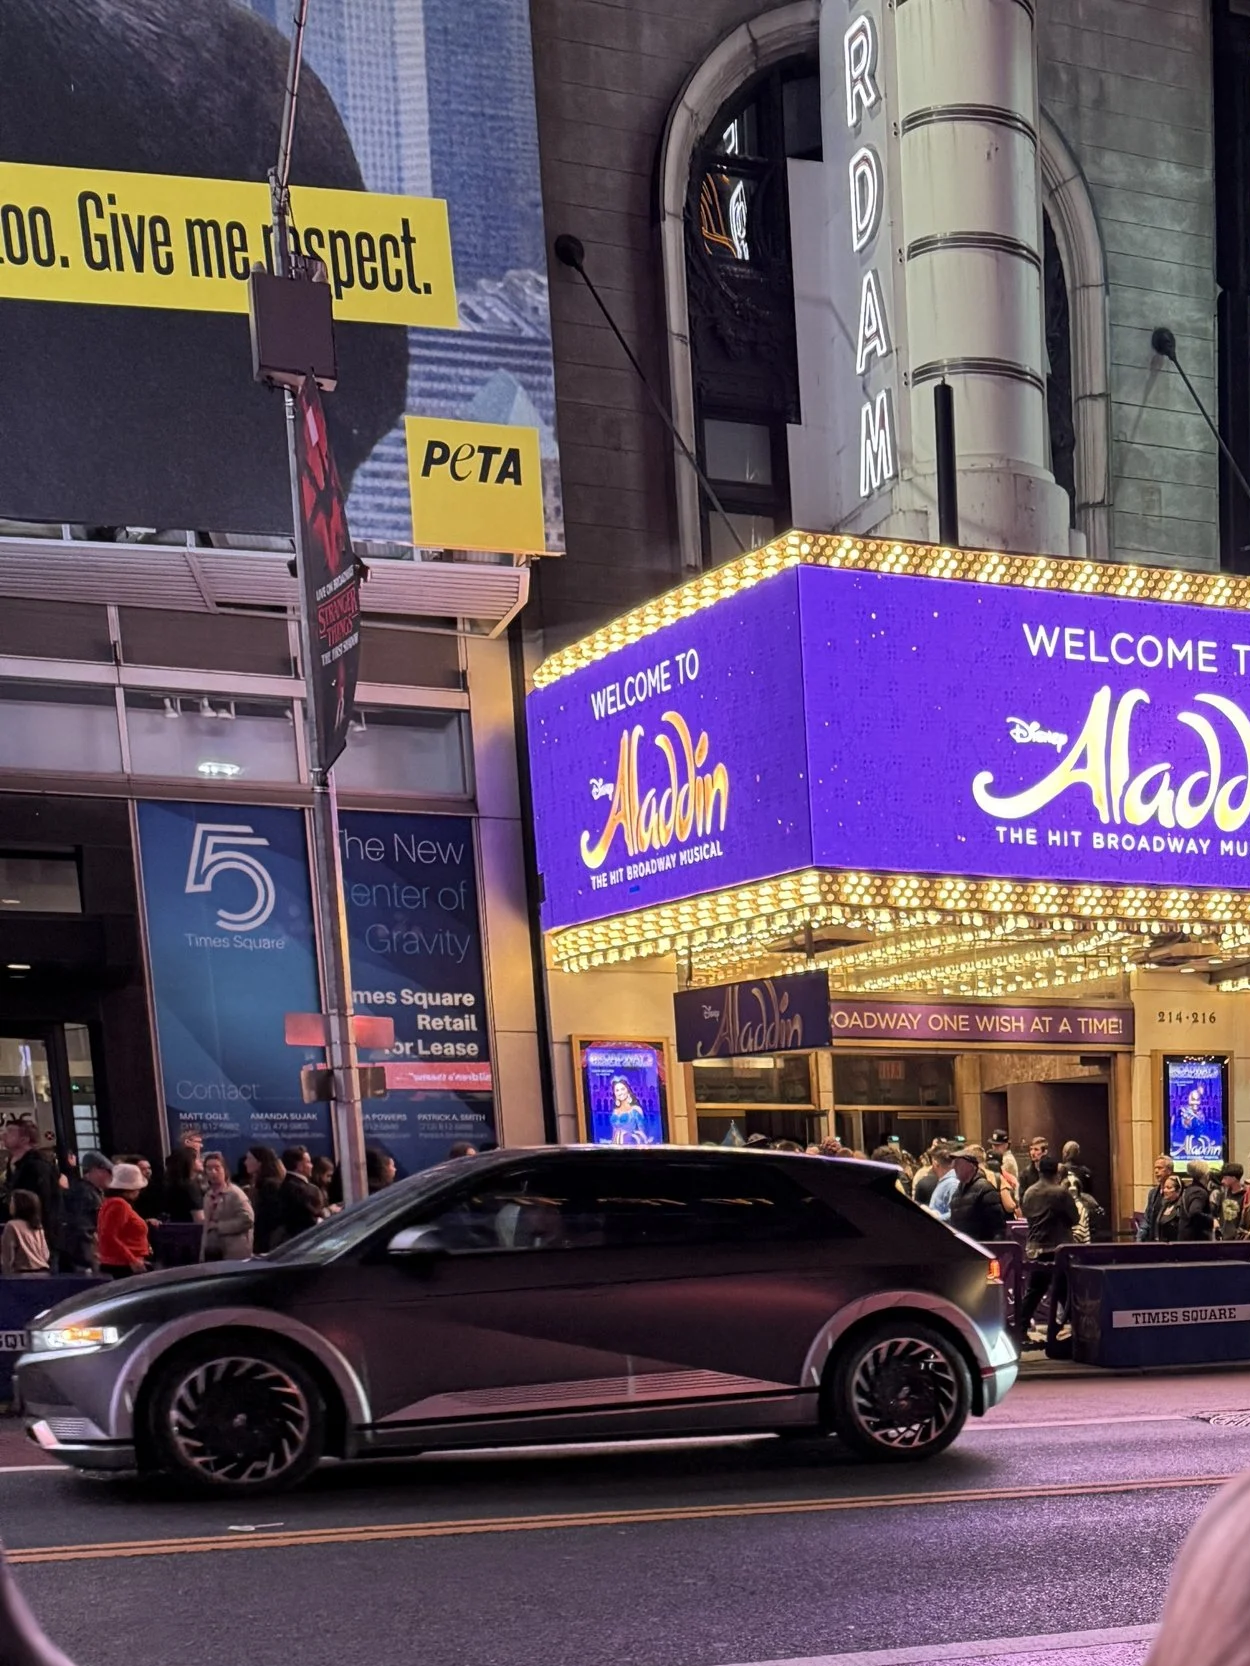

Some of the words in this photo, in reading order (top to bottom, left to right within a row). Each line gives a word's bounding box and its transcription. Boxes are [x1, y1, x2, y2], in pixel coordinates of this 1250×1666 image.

[0, 203, 70, 268] oo.
[77, 190, 175, 276] Give
[185, 218, 250, 281] me
[318, 587, 358, 634] STRANGER
[327, 616, 353, 647] THINGS
[1022, 623, 1218, 673] WELCOME
[590, 659, 672, 721] WELCOME
[675, 648, 699, 685] TO
[1006, 716, 1068, 753] Disney
[580, 710, 729, 869] Aladdin
[394, 833, 464, 864] New
[995, 826, 1038, 846] THE
[1048, 830, 1083, 849] HIT
[1092, 831, 1211, 857] BROADWAY
[185, 823, 275, 931] 5
[590, 872, 608, 890] THE
[609, 867, 624, 886] HIT
[626, 855, 677, 882] BROADWAY
[679, 840, 723, 866] MUSICAL
[344, 879, 430, 909] enter
[438, 880, 467, 911] of
[185, 933, 230, 949] Times
[233, 935, 285, 951] Square
[365, 924, 471, 964] Gravity
[353, 989, 397, 1004] mes
[400, 988, 475, 1008] Square
[417, 1014, 477, 1031] Retail
[697, 980, 803, 1058] Aladdin
[928, 1014, 970, 1032] ONE
[976, 1015, 1025, 1033] WISH
[1030, 1016, 1053, 1033] AT
[1058, 1017, 1072, 1034] A
[1077, 1017, 1123, 1034] TIME!
[385, 1042, 414, 1055] or
[417, 1039, 479, 1056] Lease
[177, 1080, 259, 1100] Contact
[250, 1113, 289, 1121] AMANDA
[290, 1113, 317, 1121] SUJAK
[1132, 1311, 1178, 1325] TIMES
[1182, 1307, 1236, 1322] SQUARE
